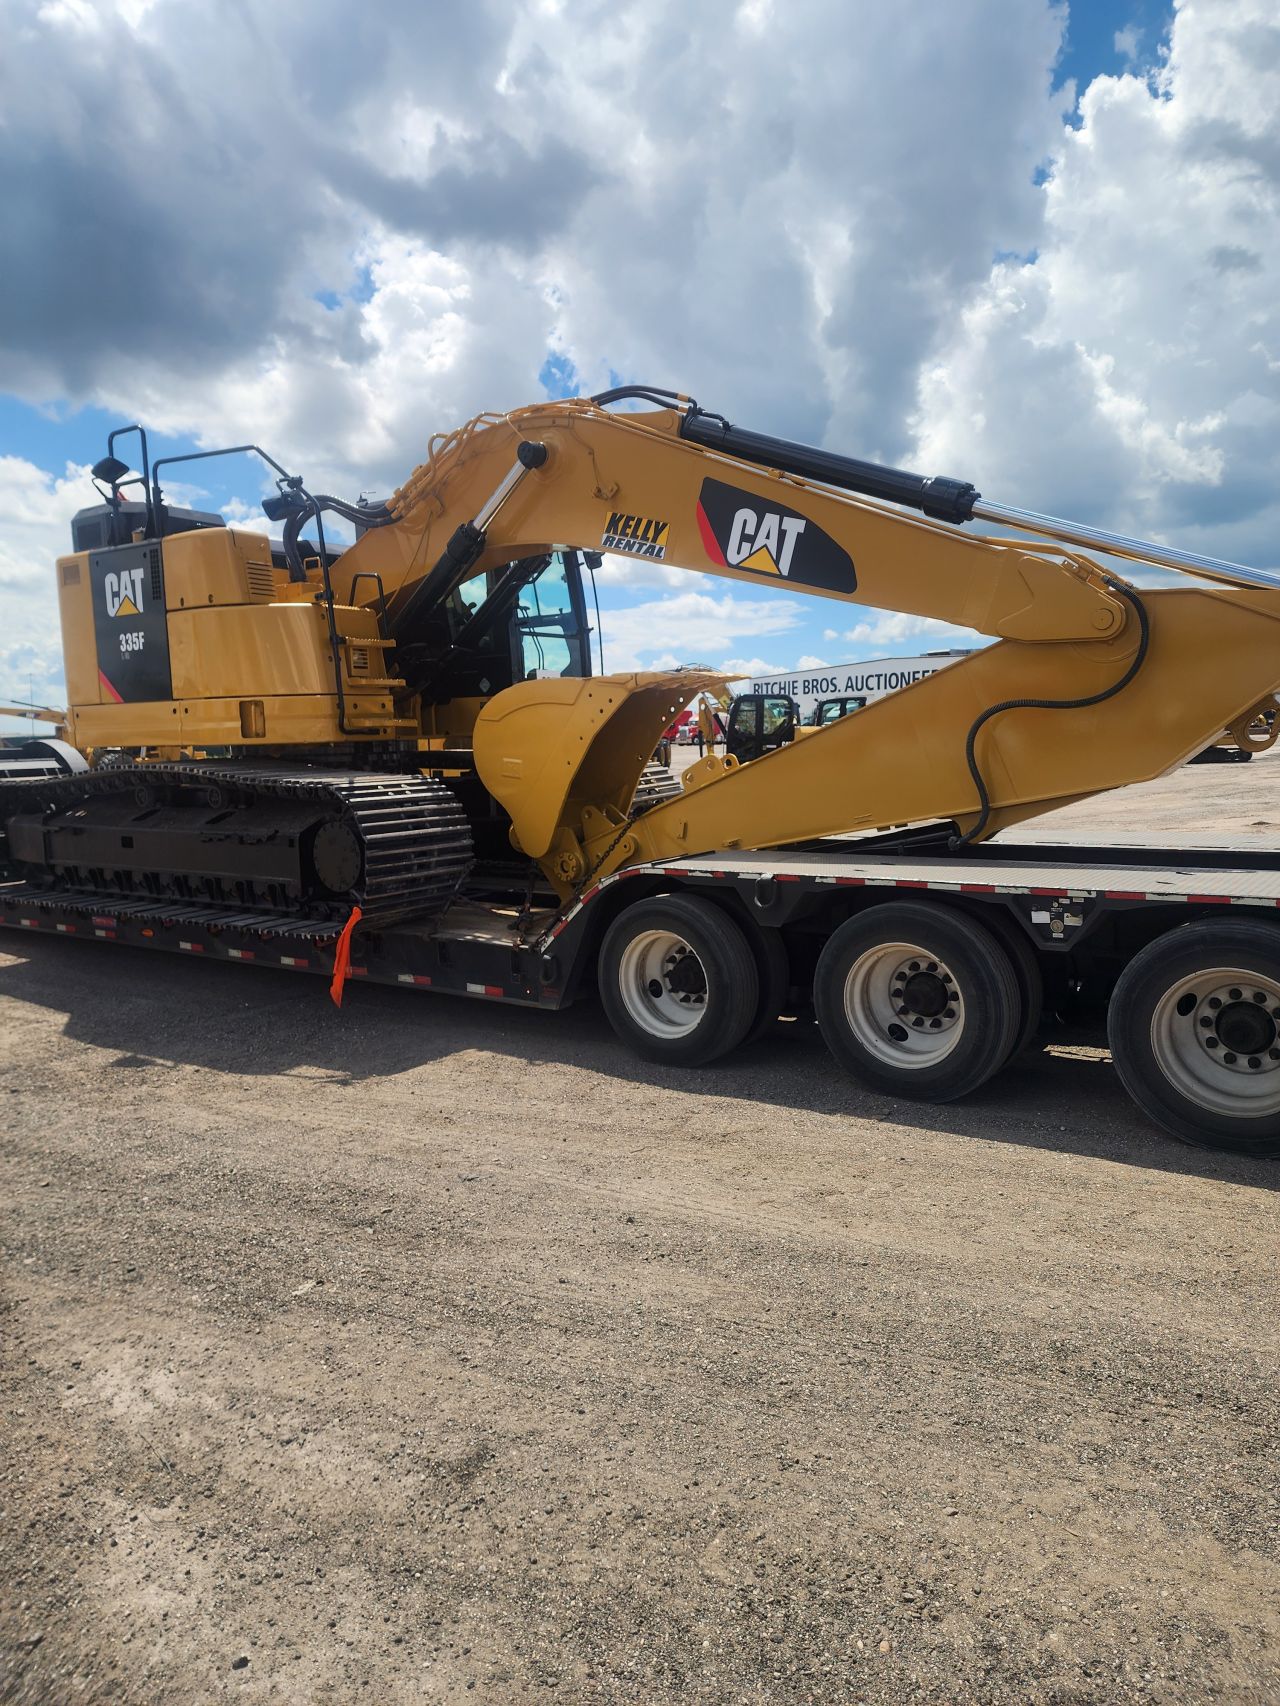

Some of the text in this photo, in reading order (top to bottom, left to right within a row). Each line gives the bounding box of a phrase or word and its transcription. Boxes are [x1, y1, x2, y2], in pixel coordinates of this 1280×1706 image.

[604, 512, 669, 543] KELLY
[602, 535, 665, 558] RENTAL
[726, 507, 807, 577] CAT
[104, 567, 145, 618] CAT
[119, 631, 145, 652] 335F
[753, 680, 799, 696] RITCHIE
[802, 677, 841, 695] BROS.
